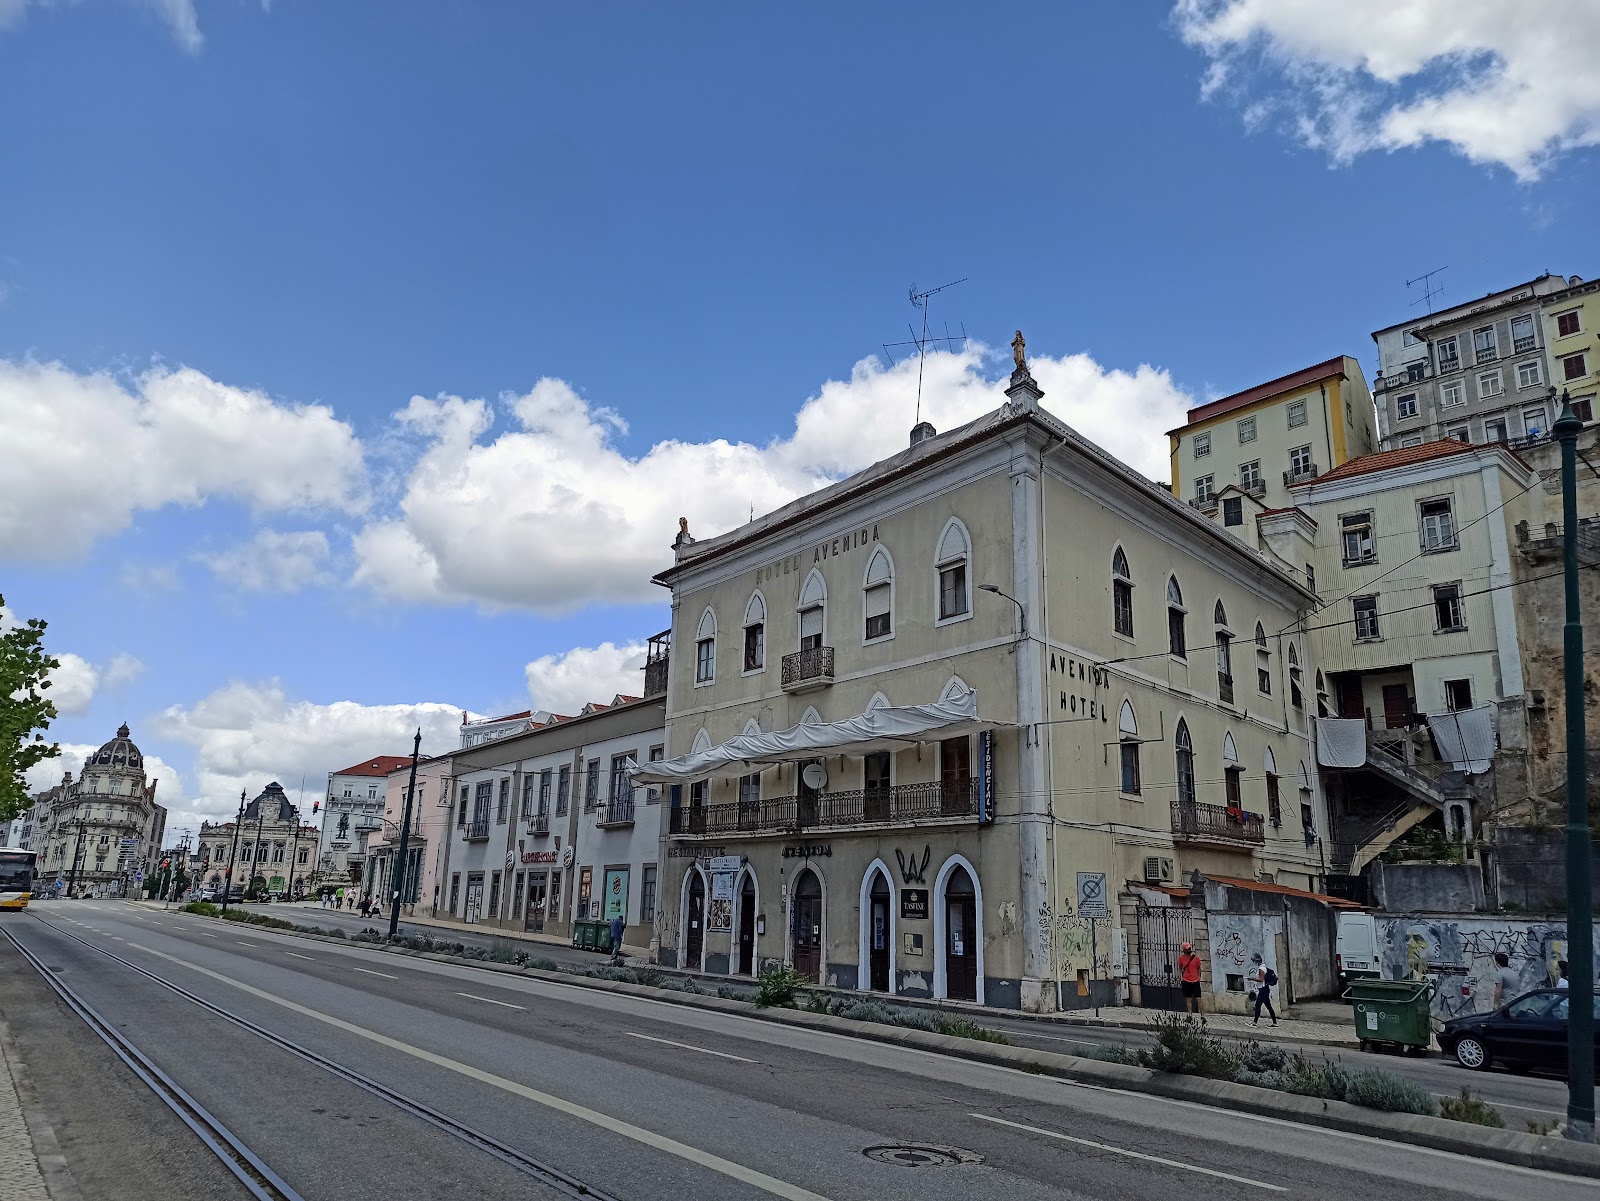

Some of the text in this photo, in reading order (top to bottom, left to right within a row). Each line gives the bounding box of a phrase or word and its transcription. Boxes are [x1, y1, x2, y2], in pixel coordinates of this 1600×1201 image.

[756, 525, 880, 586] HOTEL AVENIDA
[1051, 653, 1110, 689] AVENIDA
[1061, 691, 1108, 723] HOTEL
